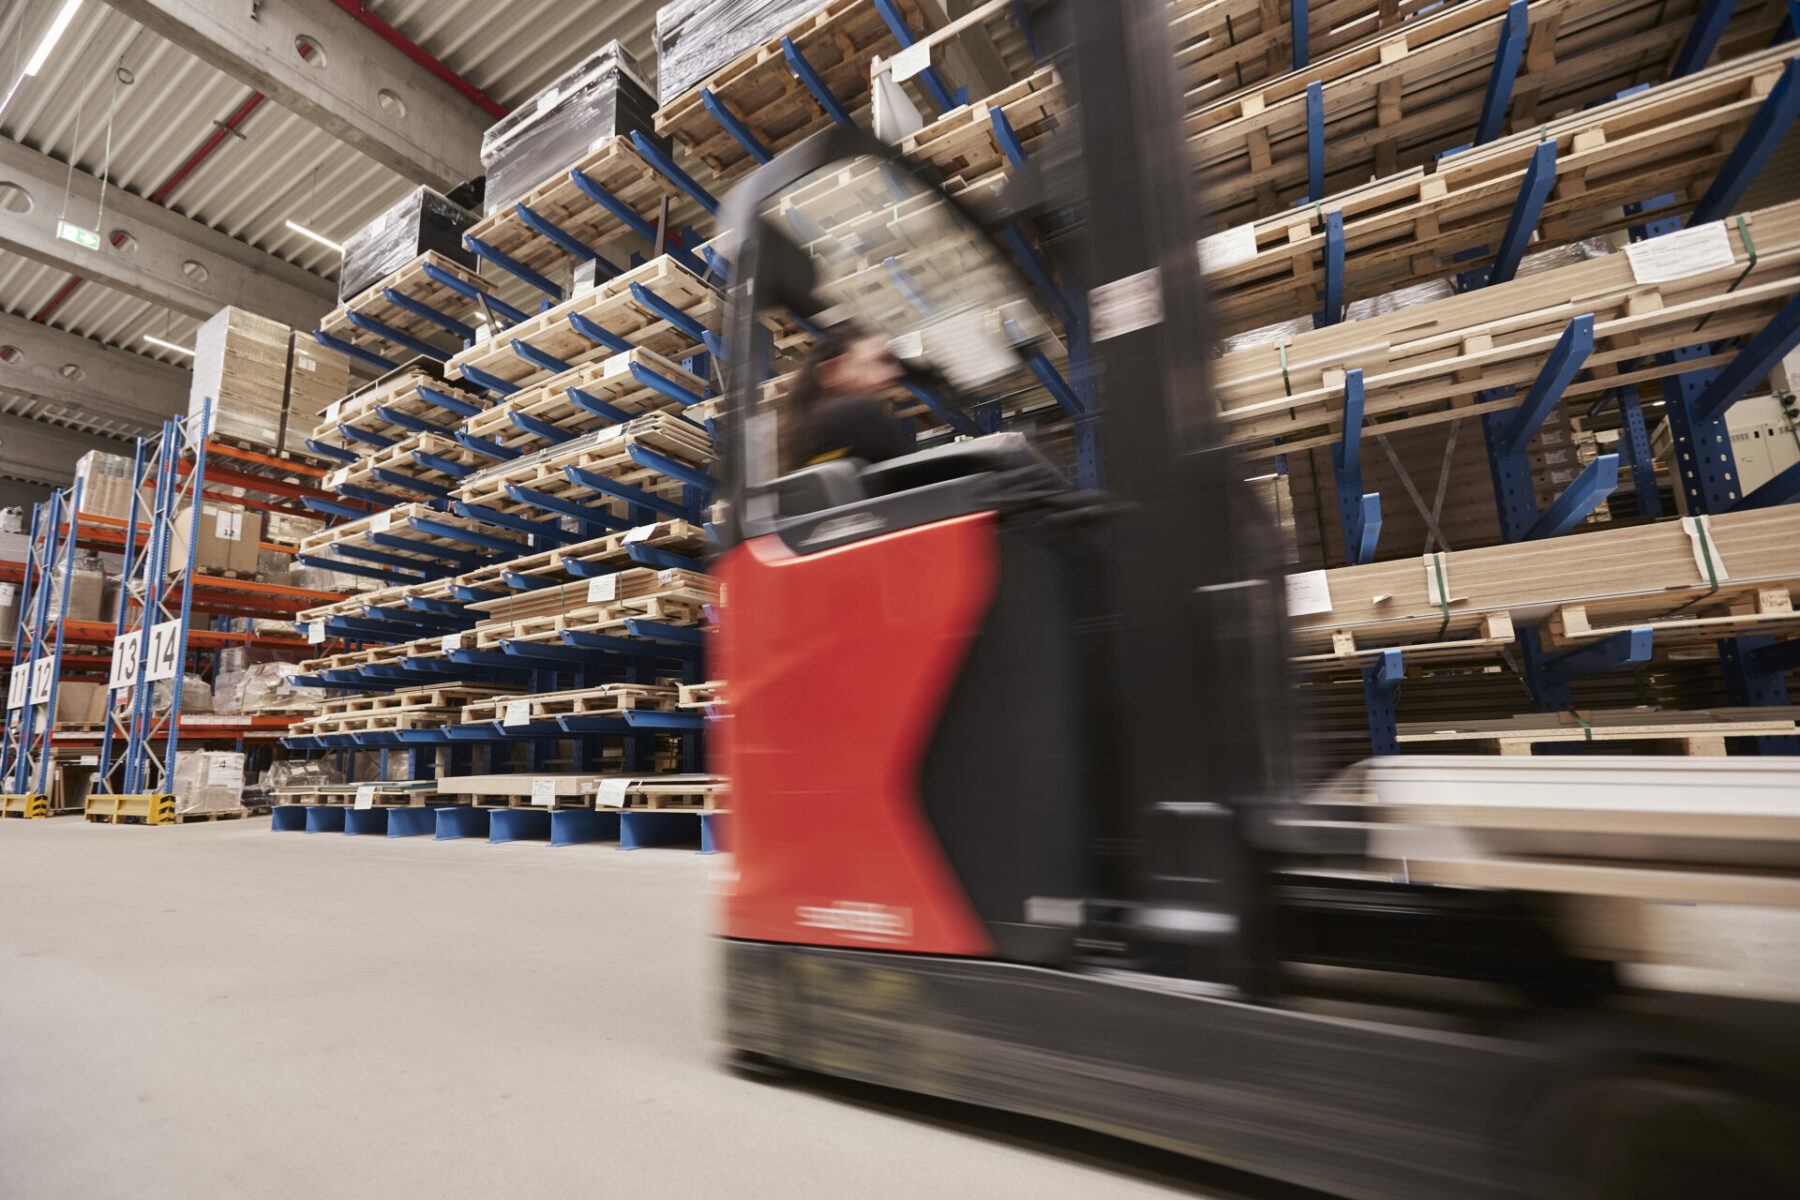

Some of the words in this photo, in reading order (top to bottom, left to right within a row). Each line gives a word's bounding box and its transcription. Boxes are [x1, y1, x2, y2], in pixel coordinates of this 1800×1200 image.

[224, 528, 235, 537] 12
[116, 637, 138, 681] 13
[153, 626, 177, 673] 14
[12, 669, 26, 704] 11
[35, 661, 51, 699] 12
